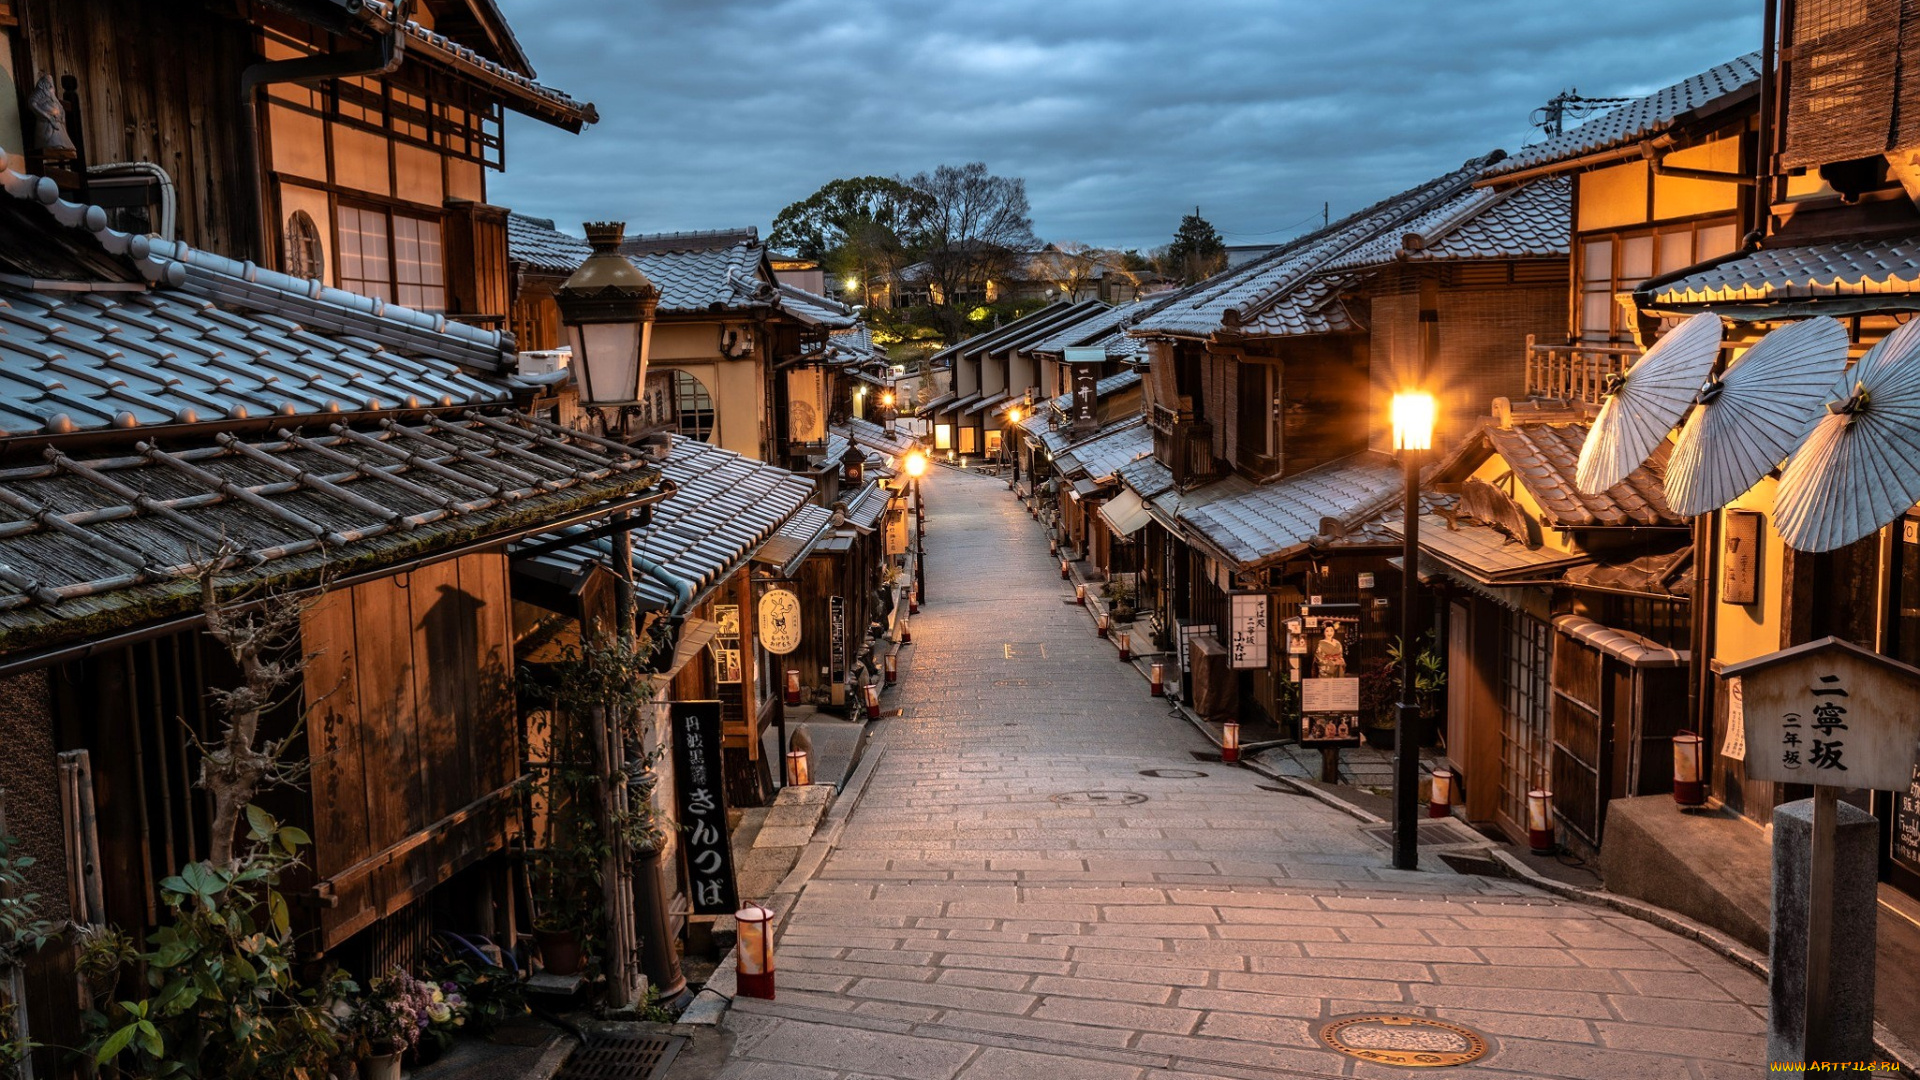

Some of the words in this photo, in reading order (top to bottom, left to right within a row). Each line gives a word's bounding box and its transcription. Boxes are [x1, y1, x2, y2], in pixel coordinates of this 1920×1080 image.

[1234, 631, 1246, 661] ふたば
[1809, 675, 1849, 771] 二寧坂
[688, 788, 724, 906] きんつば
